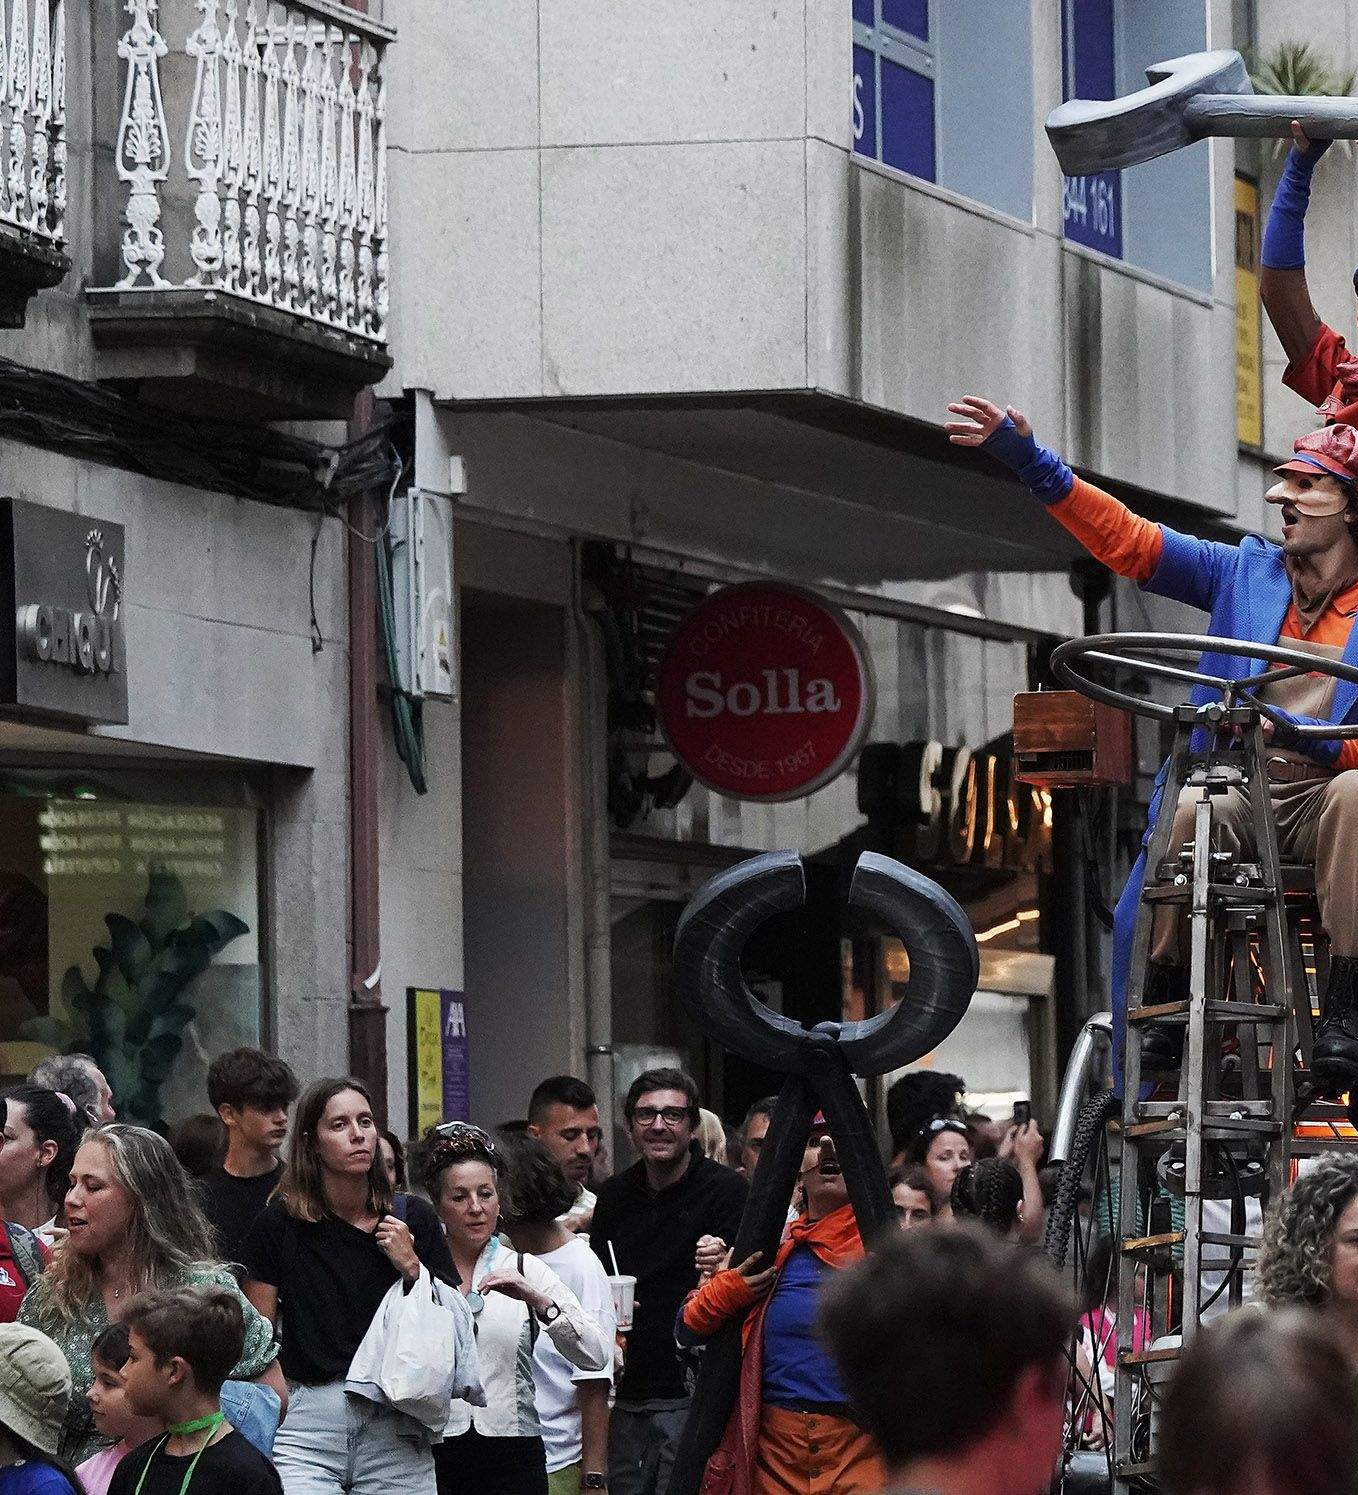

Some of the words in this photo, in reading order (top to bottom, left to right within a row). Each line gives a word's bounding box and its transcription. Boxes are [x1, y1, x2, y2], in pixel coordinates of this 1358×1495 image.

[1090, 177, 1115, 238] 161
[685, 667, 842, 718] Solla
[704, 744, 770, 779] DESDE
[776, 740, 818, 777] 1967
